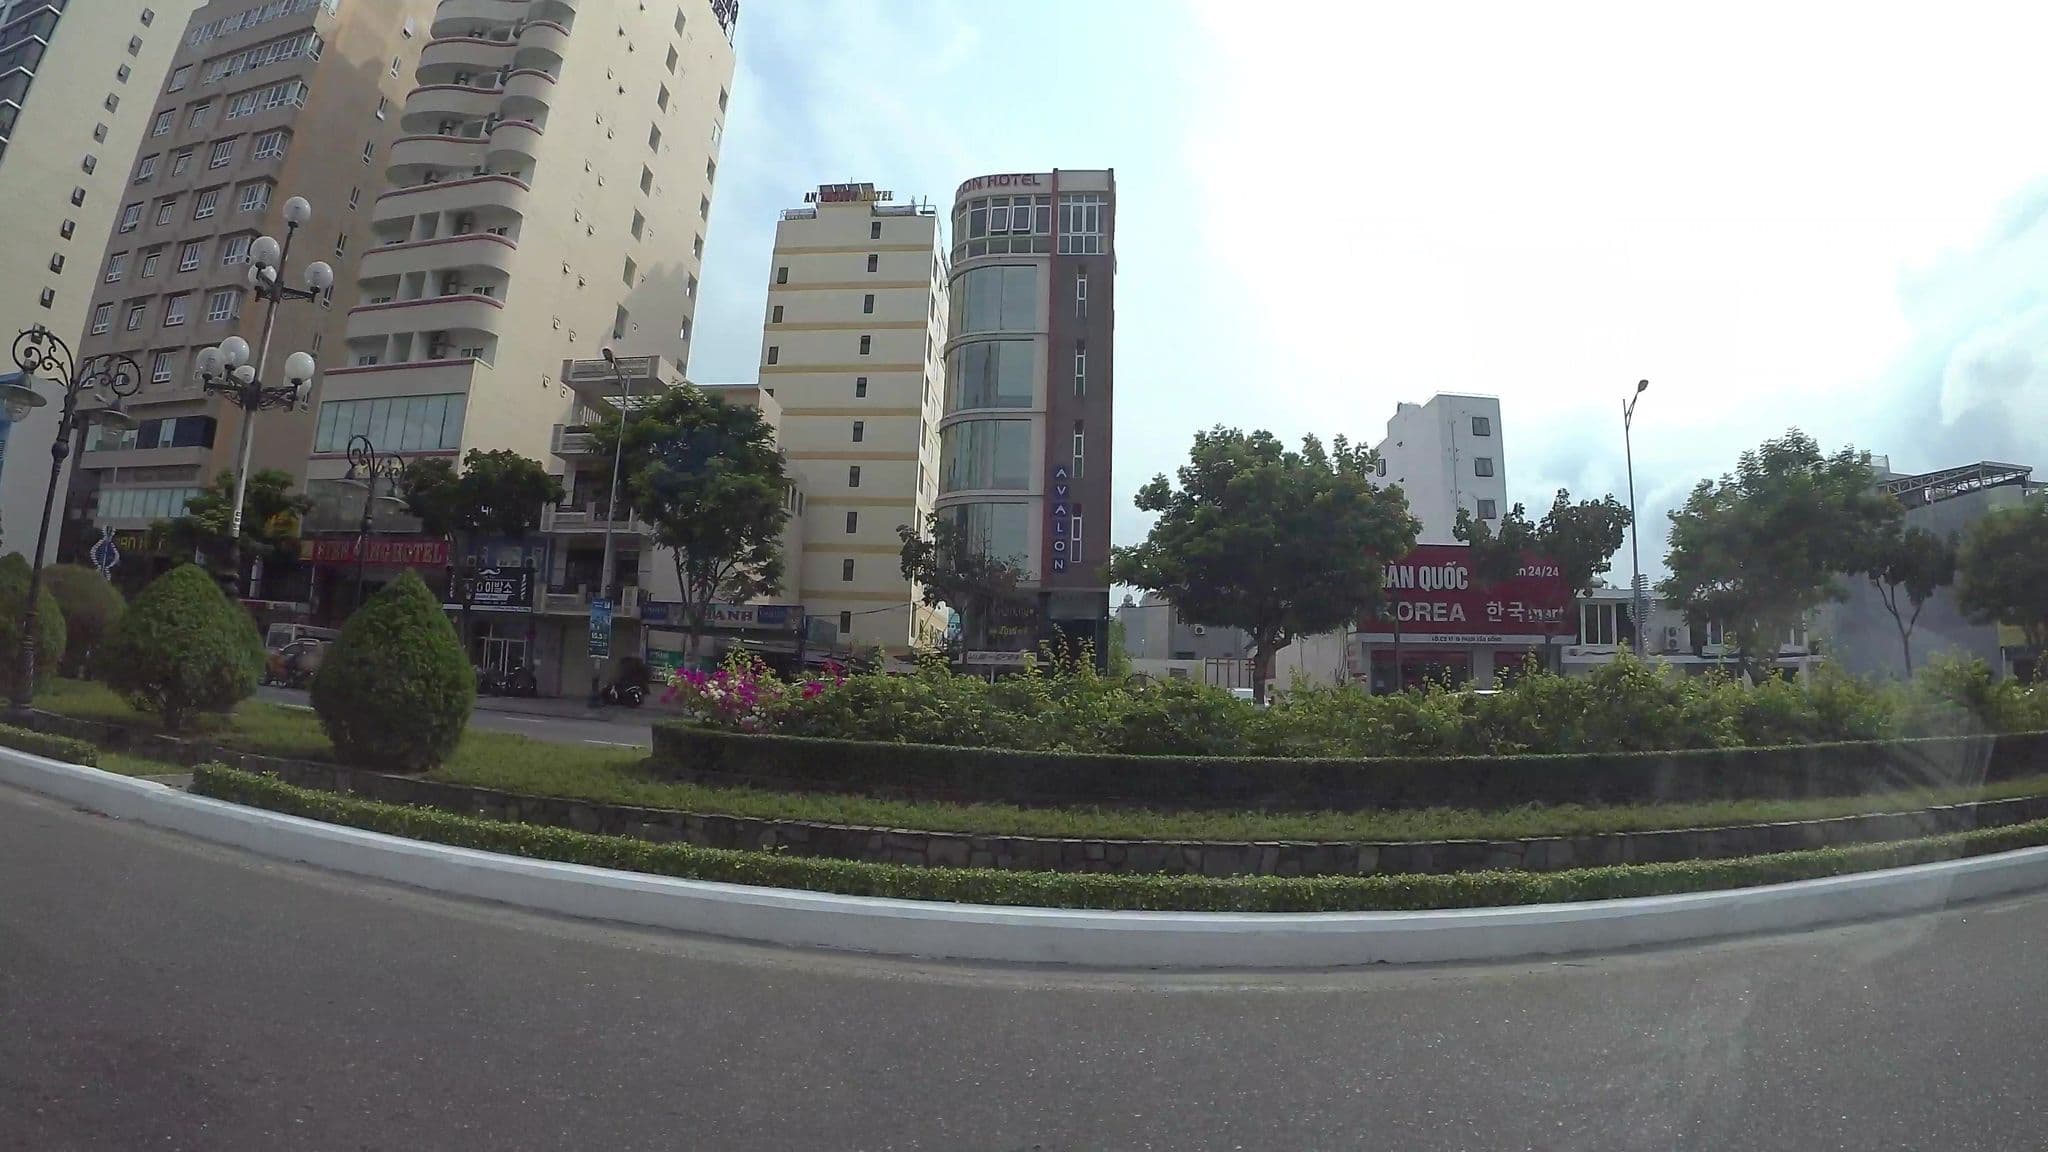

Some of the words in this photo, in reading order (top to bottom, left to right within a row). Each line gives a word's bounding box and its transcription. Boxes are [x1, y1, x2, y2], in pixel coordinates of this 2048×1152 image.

[988, 174, 1041, 187] HOTEL
[1054, 468, 1067, 570] AVALON
[1419, 561, 1469, 591] QUỐC
[1528, 566, 1559, 577] 24/24
[485, 581, 513, 594] 이발소
[1485, 601, 1526, 622] 한국
